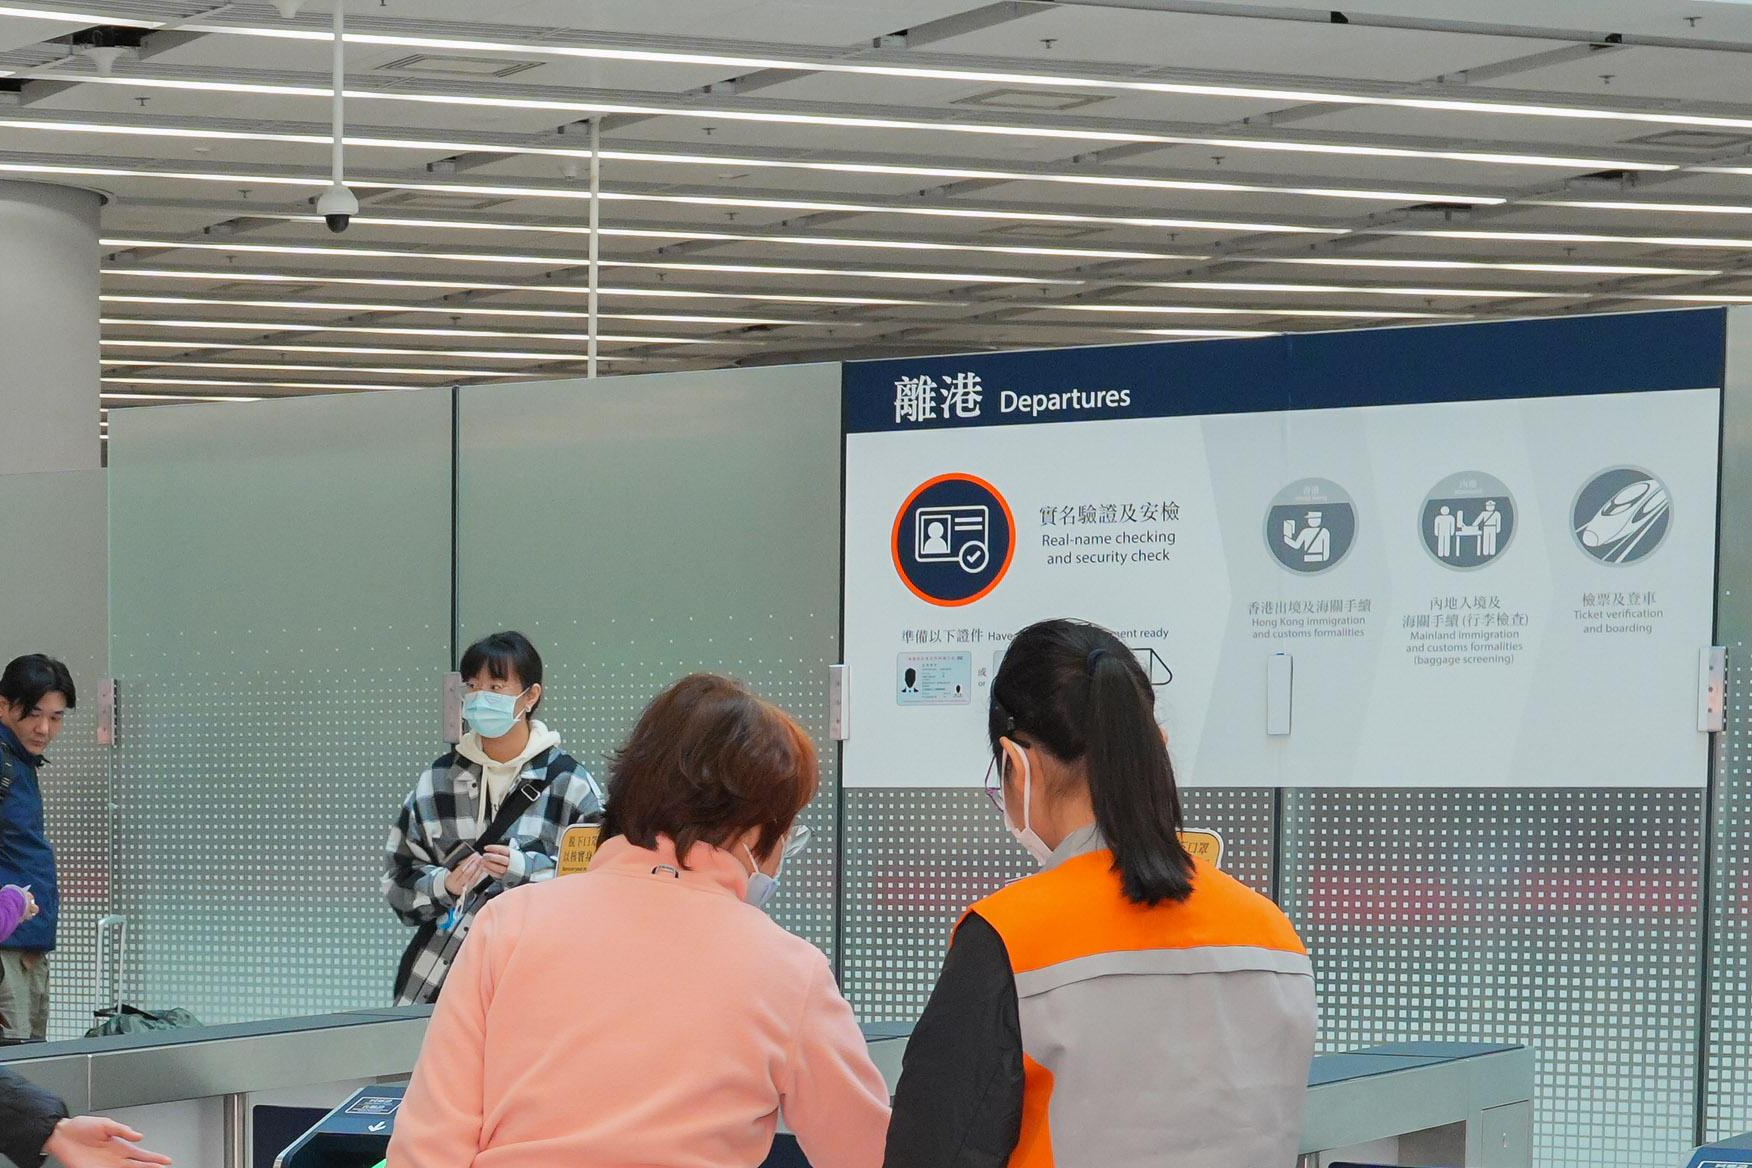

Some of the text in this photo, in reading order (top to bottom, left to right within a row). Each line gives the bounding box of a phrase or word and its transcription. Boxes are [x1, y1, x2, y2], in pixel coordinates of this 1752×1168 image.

[893, 372, 984, 423] 離港
[999, 388, 1131, 416] Departures
[1038, 501, 1180, 527] 實名驗證及安檢
[1042, 531, 1176, 548] Real-name checking
[1047, 549, 1170, 567] and security check
[1573, 608, 1664, 620] Ticket verification
[1251, 616, 1366, 629] Hong Kong immigration
[1583, 623, 1653, 635] and boarding
[987, 631, 1014, 642] Have
[1139, 626, 1169, 641] ready
[1252, 628, 1365, 639] and customs formalities
[1410, 629, 1520, 642] Mainland immigration
[1405, 641, 1524, 653] and customs formalities
